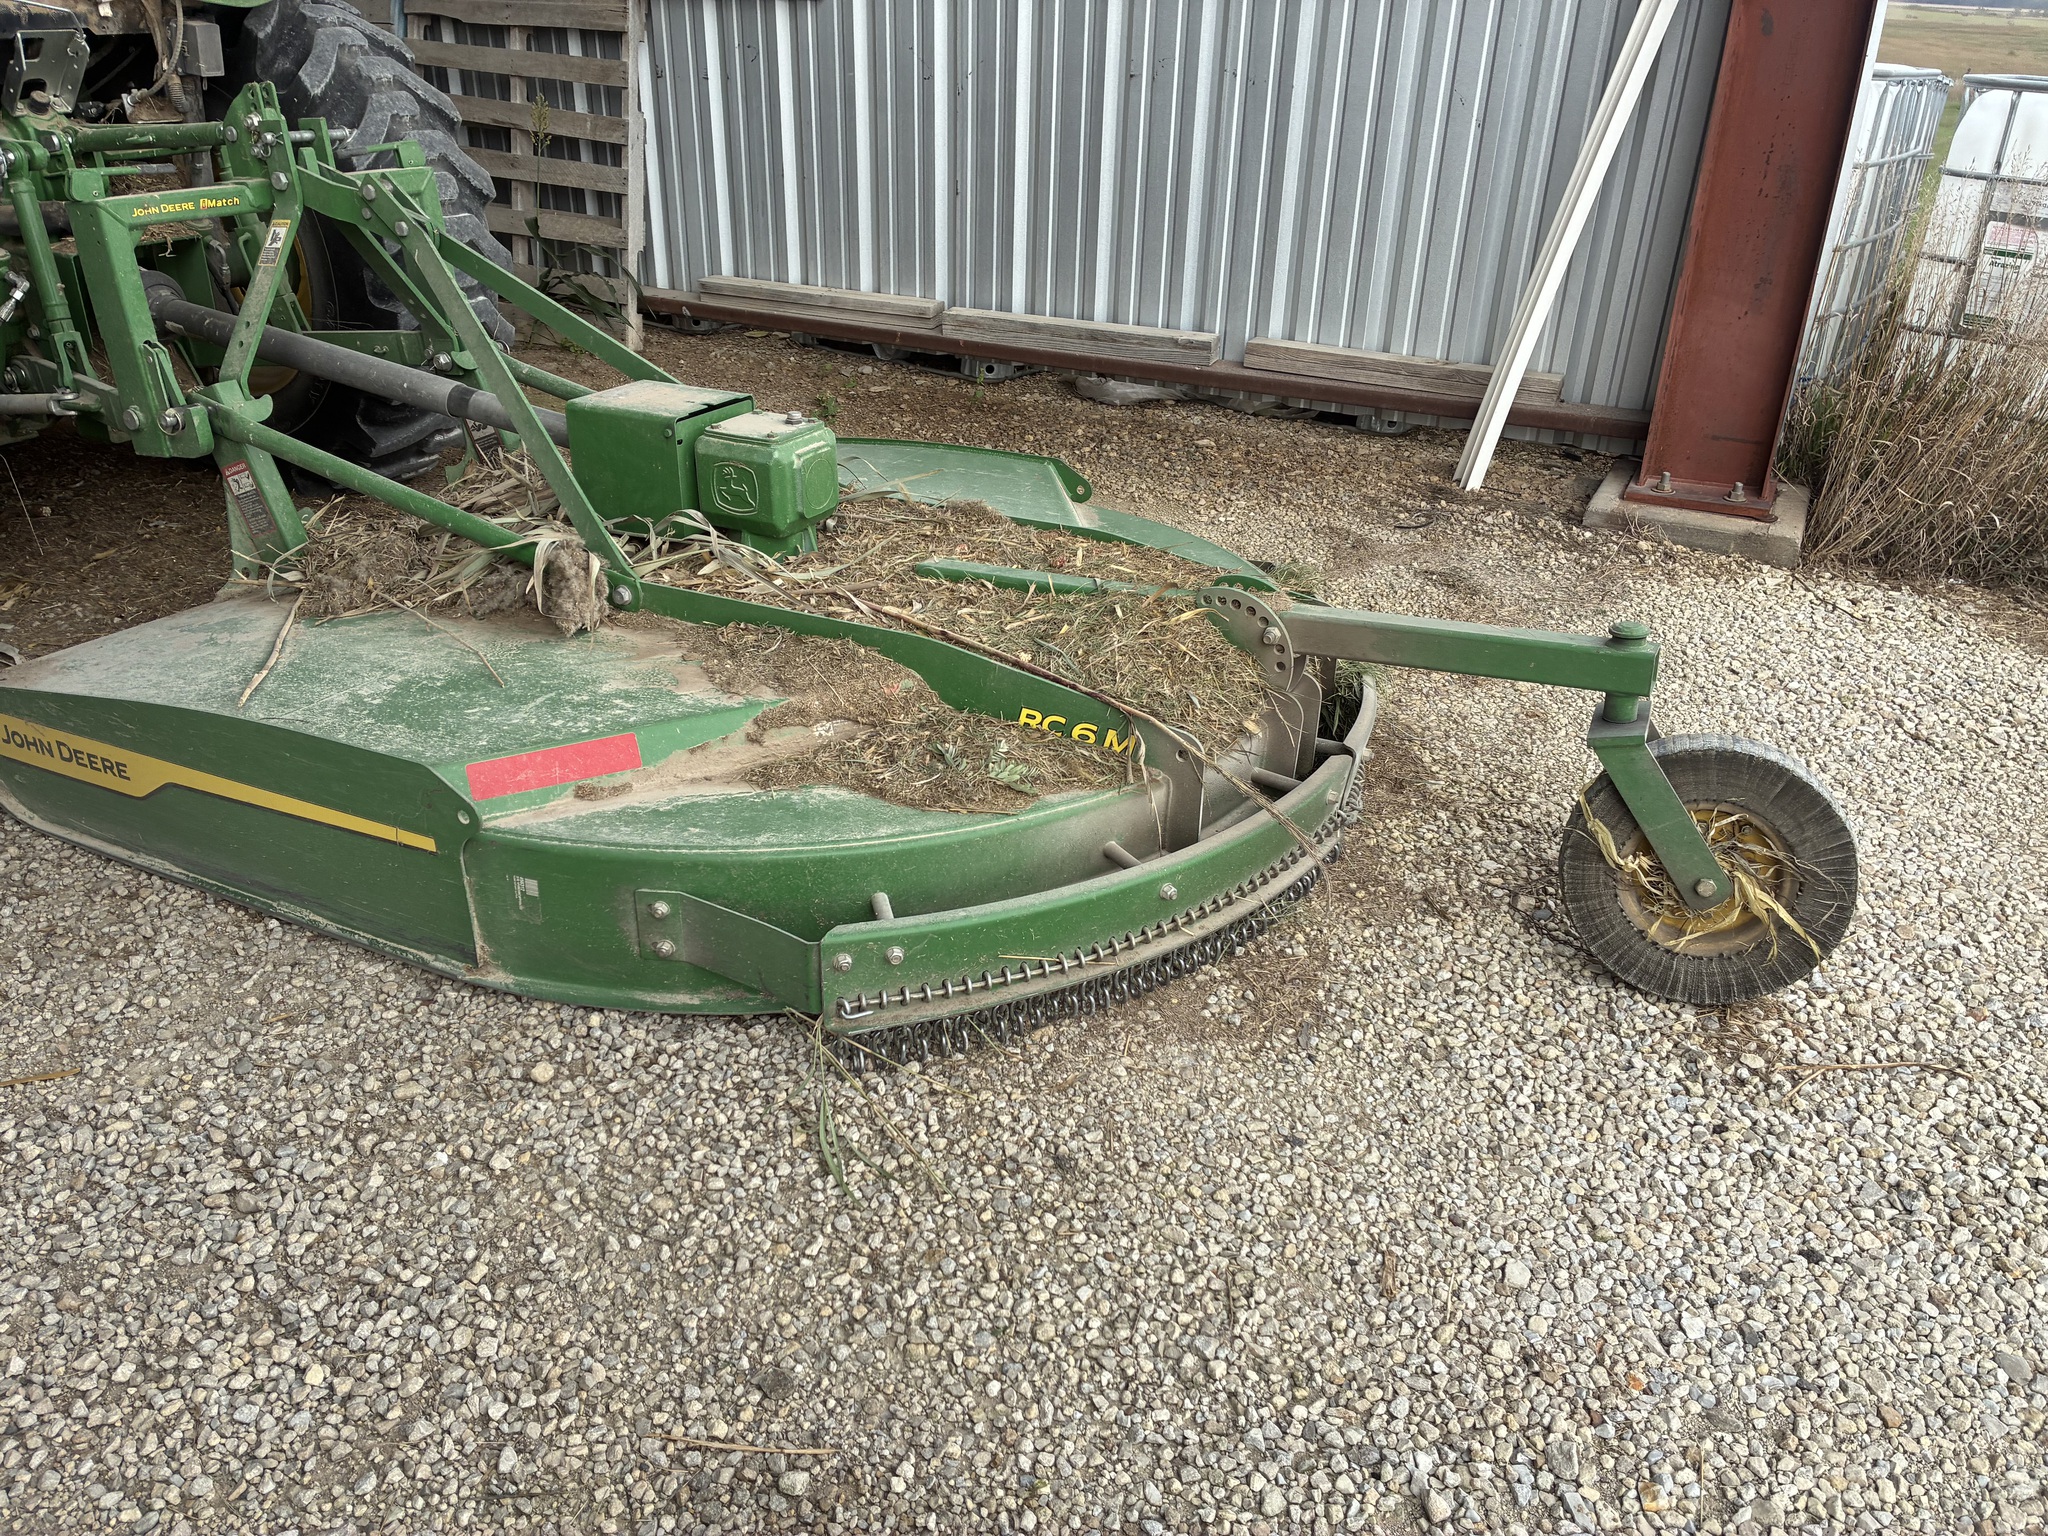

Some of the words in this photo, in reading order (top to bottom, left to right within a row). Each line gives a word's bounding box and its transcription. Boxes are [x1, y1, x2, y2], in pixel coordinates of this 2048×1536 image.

[132, 206, 160, 217] JOHN
[160, 202, 196, 213] DEERE
[2, 724, 55, 759] JOHN
[55, 740, 131, 781] DEERE
